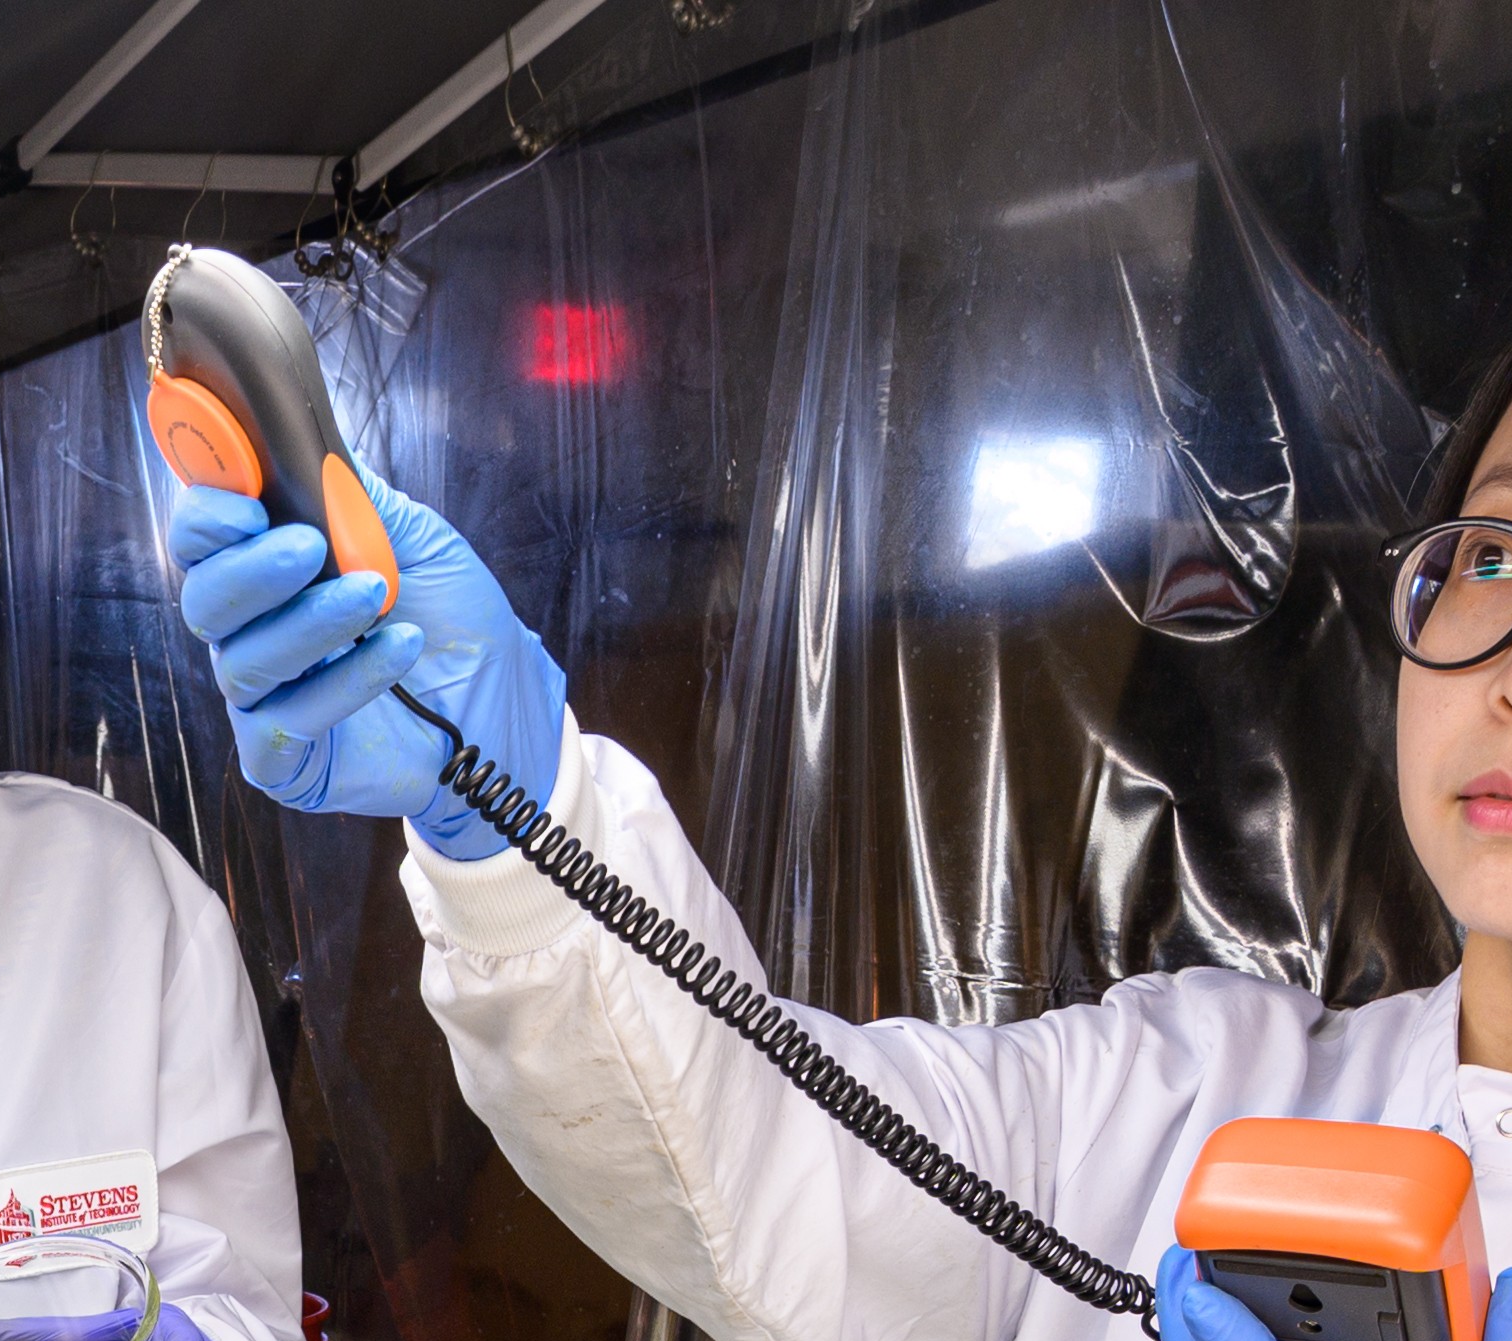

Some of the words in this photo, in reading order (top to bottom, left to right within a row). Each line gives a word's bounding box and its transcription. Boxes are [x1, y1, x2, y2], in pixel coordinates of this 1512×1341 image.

[39, 1185, 139, 1217] STEVENS
[40, 1214, 78, 1229] INSTITUTE
[79, 1210, 88, 1226] of
[89, 1203, 141, 1219] TECHNOLOGY
